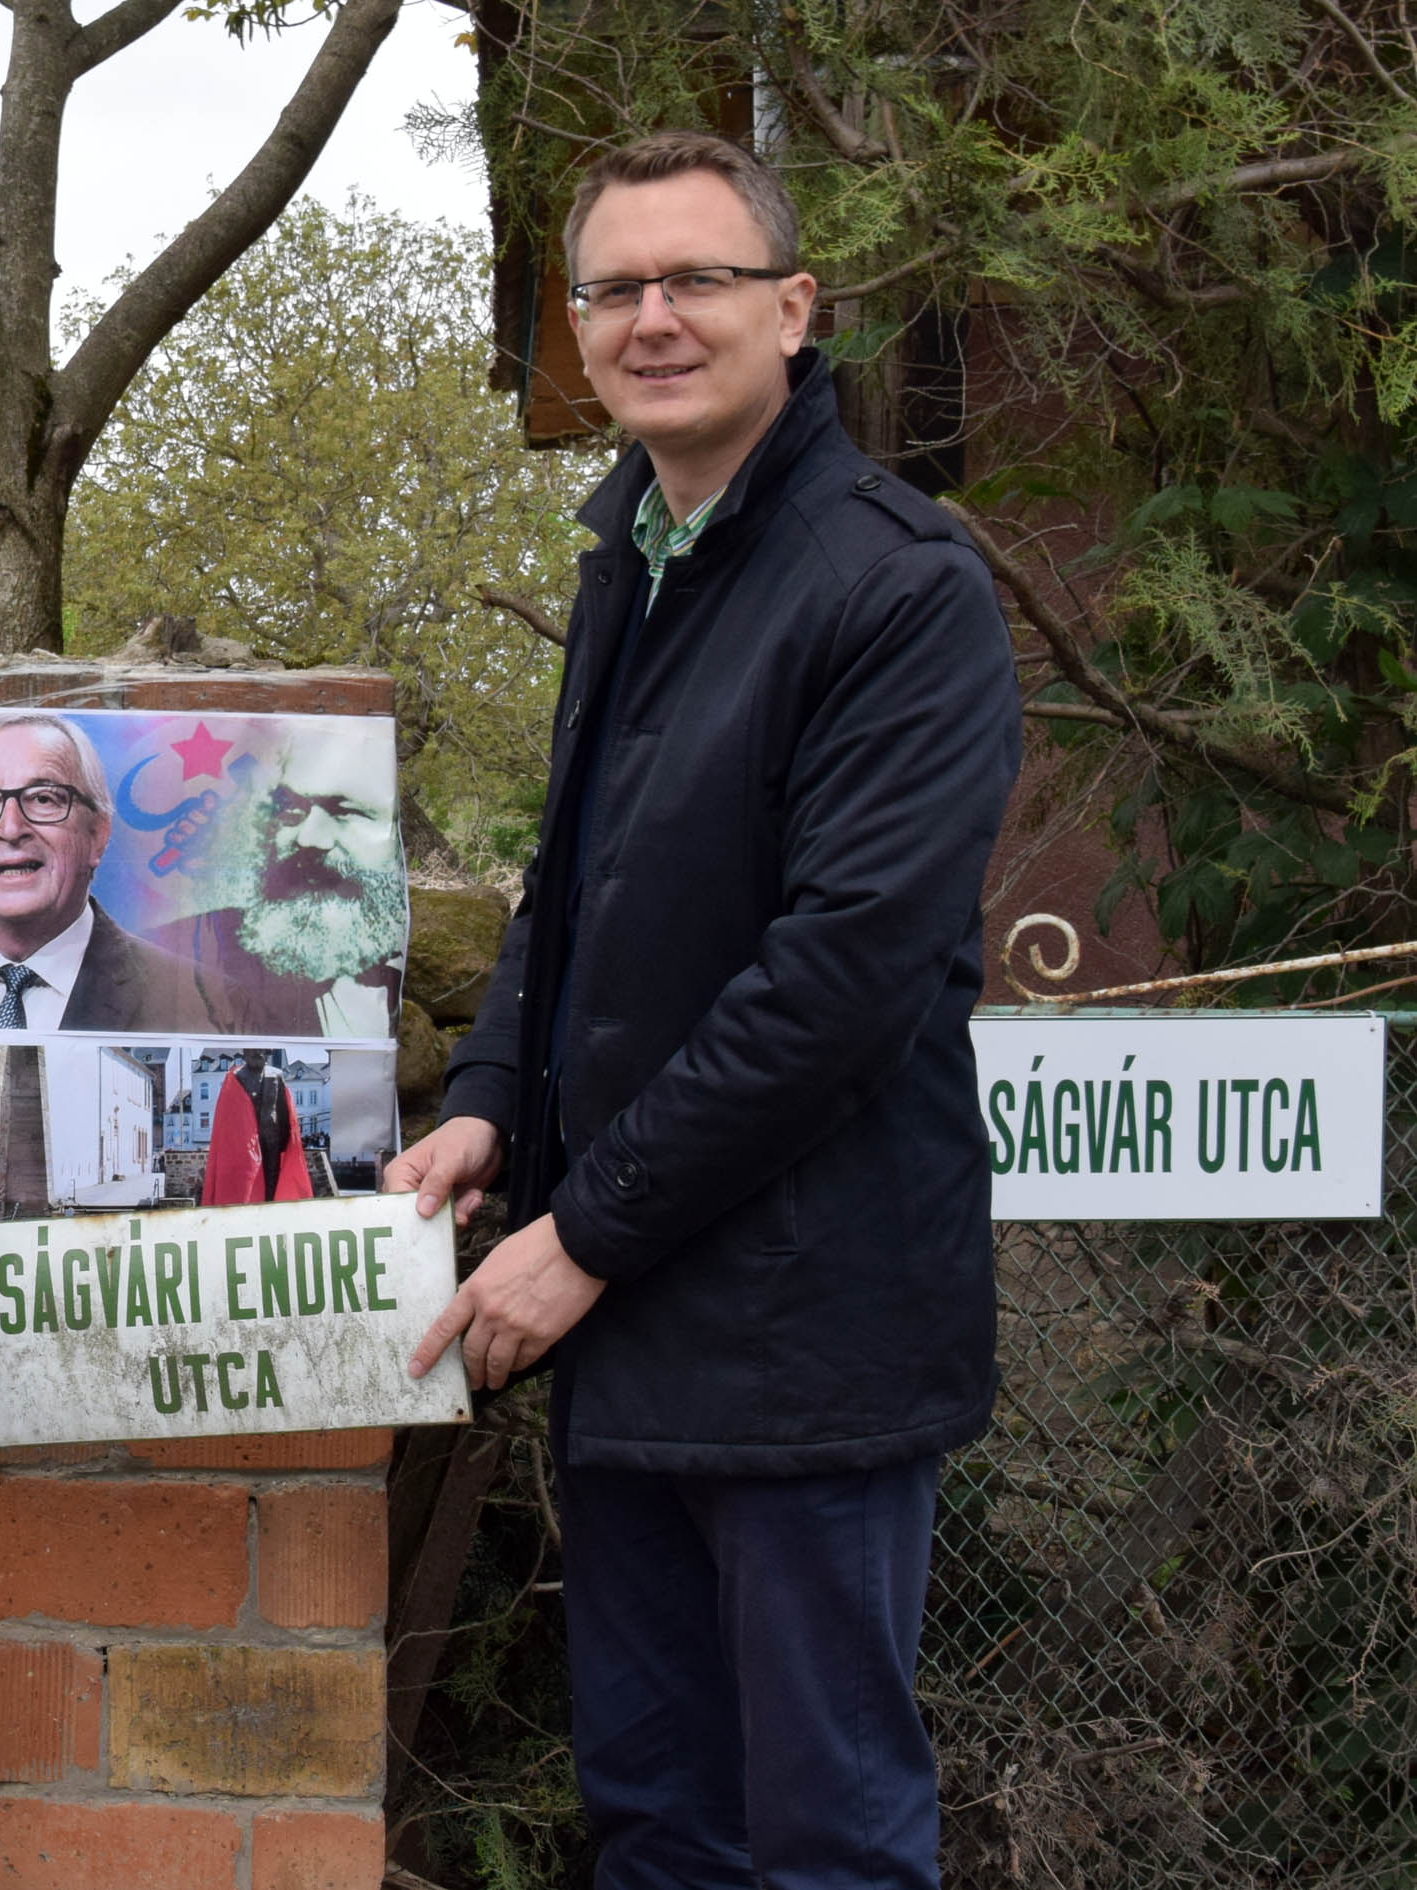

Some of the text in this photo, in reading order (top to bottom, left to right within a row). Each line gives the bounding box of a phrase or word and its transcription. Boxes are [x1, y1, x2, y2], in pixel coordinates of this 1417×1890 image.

[988, 1054, 1322, 1175] SÁGVÁR UTCA
[225, 1226, 398, 1322] ENDRE
[149, 1350, 284, 1415] UTCA
